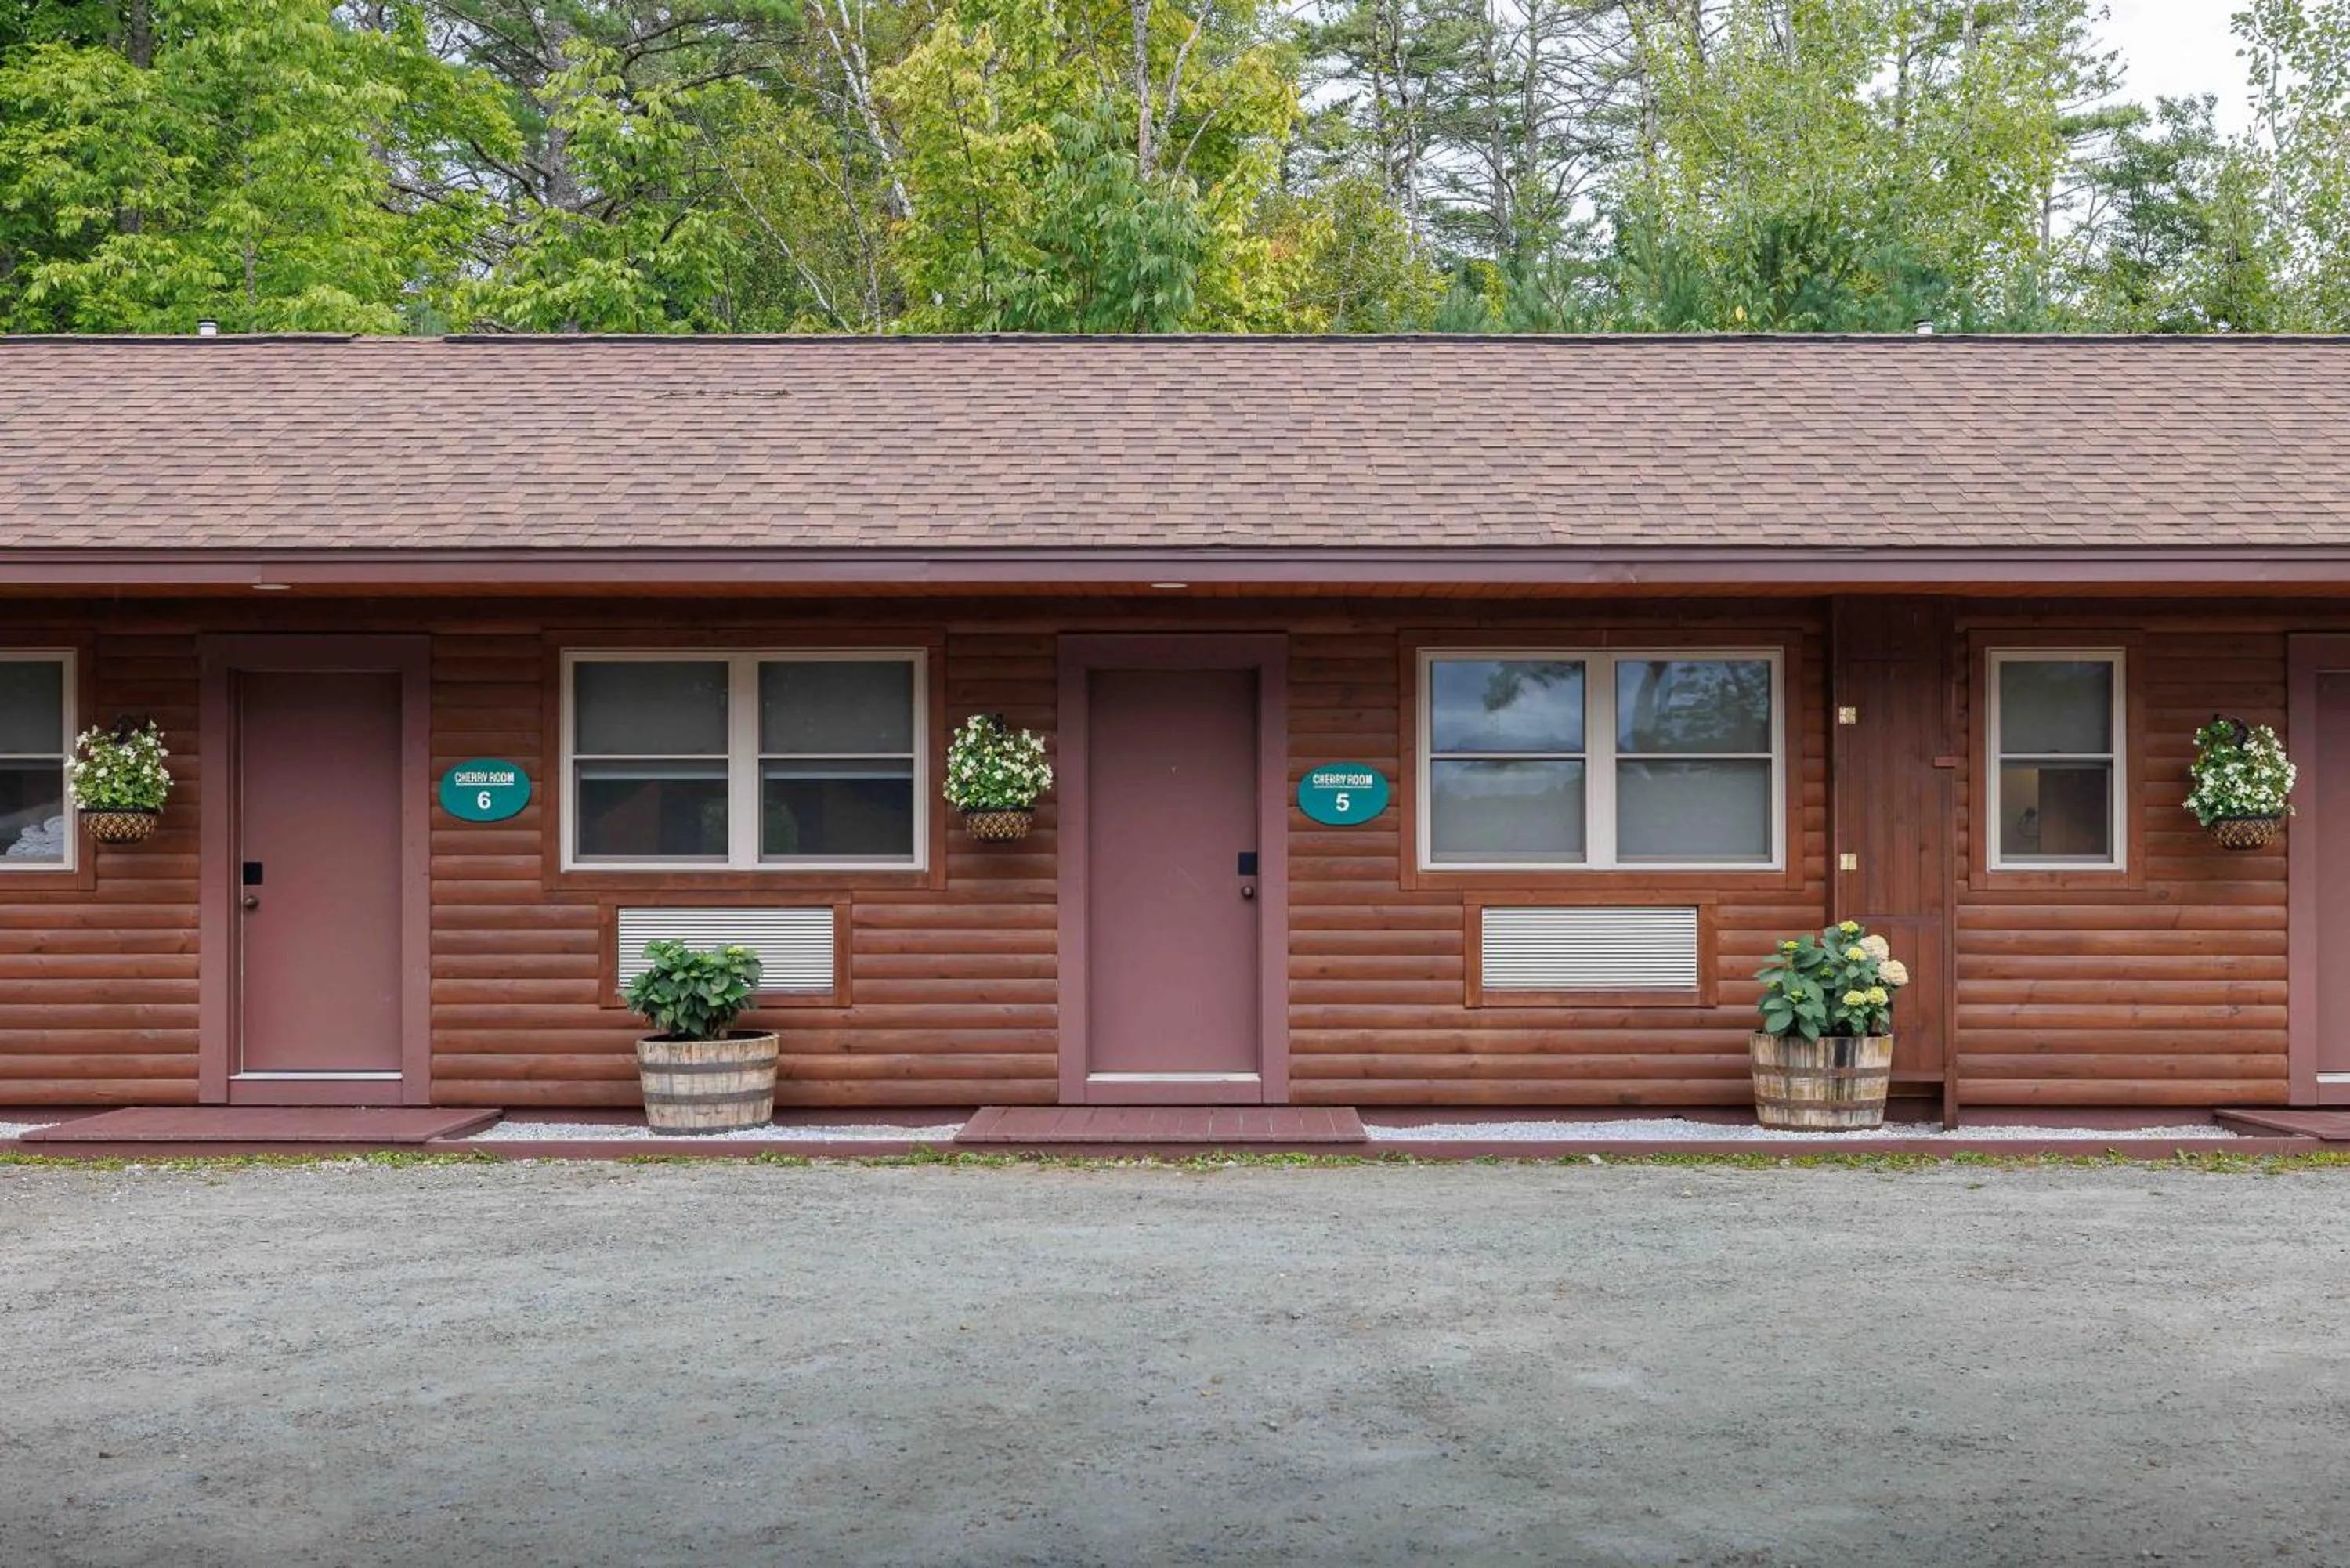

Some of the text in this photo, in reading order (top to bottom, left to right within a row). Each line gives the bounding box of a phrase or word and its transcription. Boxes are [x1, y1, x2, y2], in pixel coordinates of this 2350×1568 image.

[455, 771, 515, 782] CHERRY ROOM
[1313, 774, 1373, 786] CHERRY ROOM
[477, 791, 491, 809] 6
[1336, 793, 1350, 811] 5
